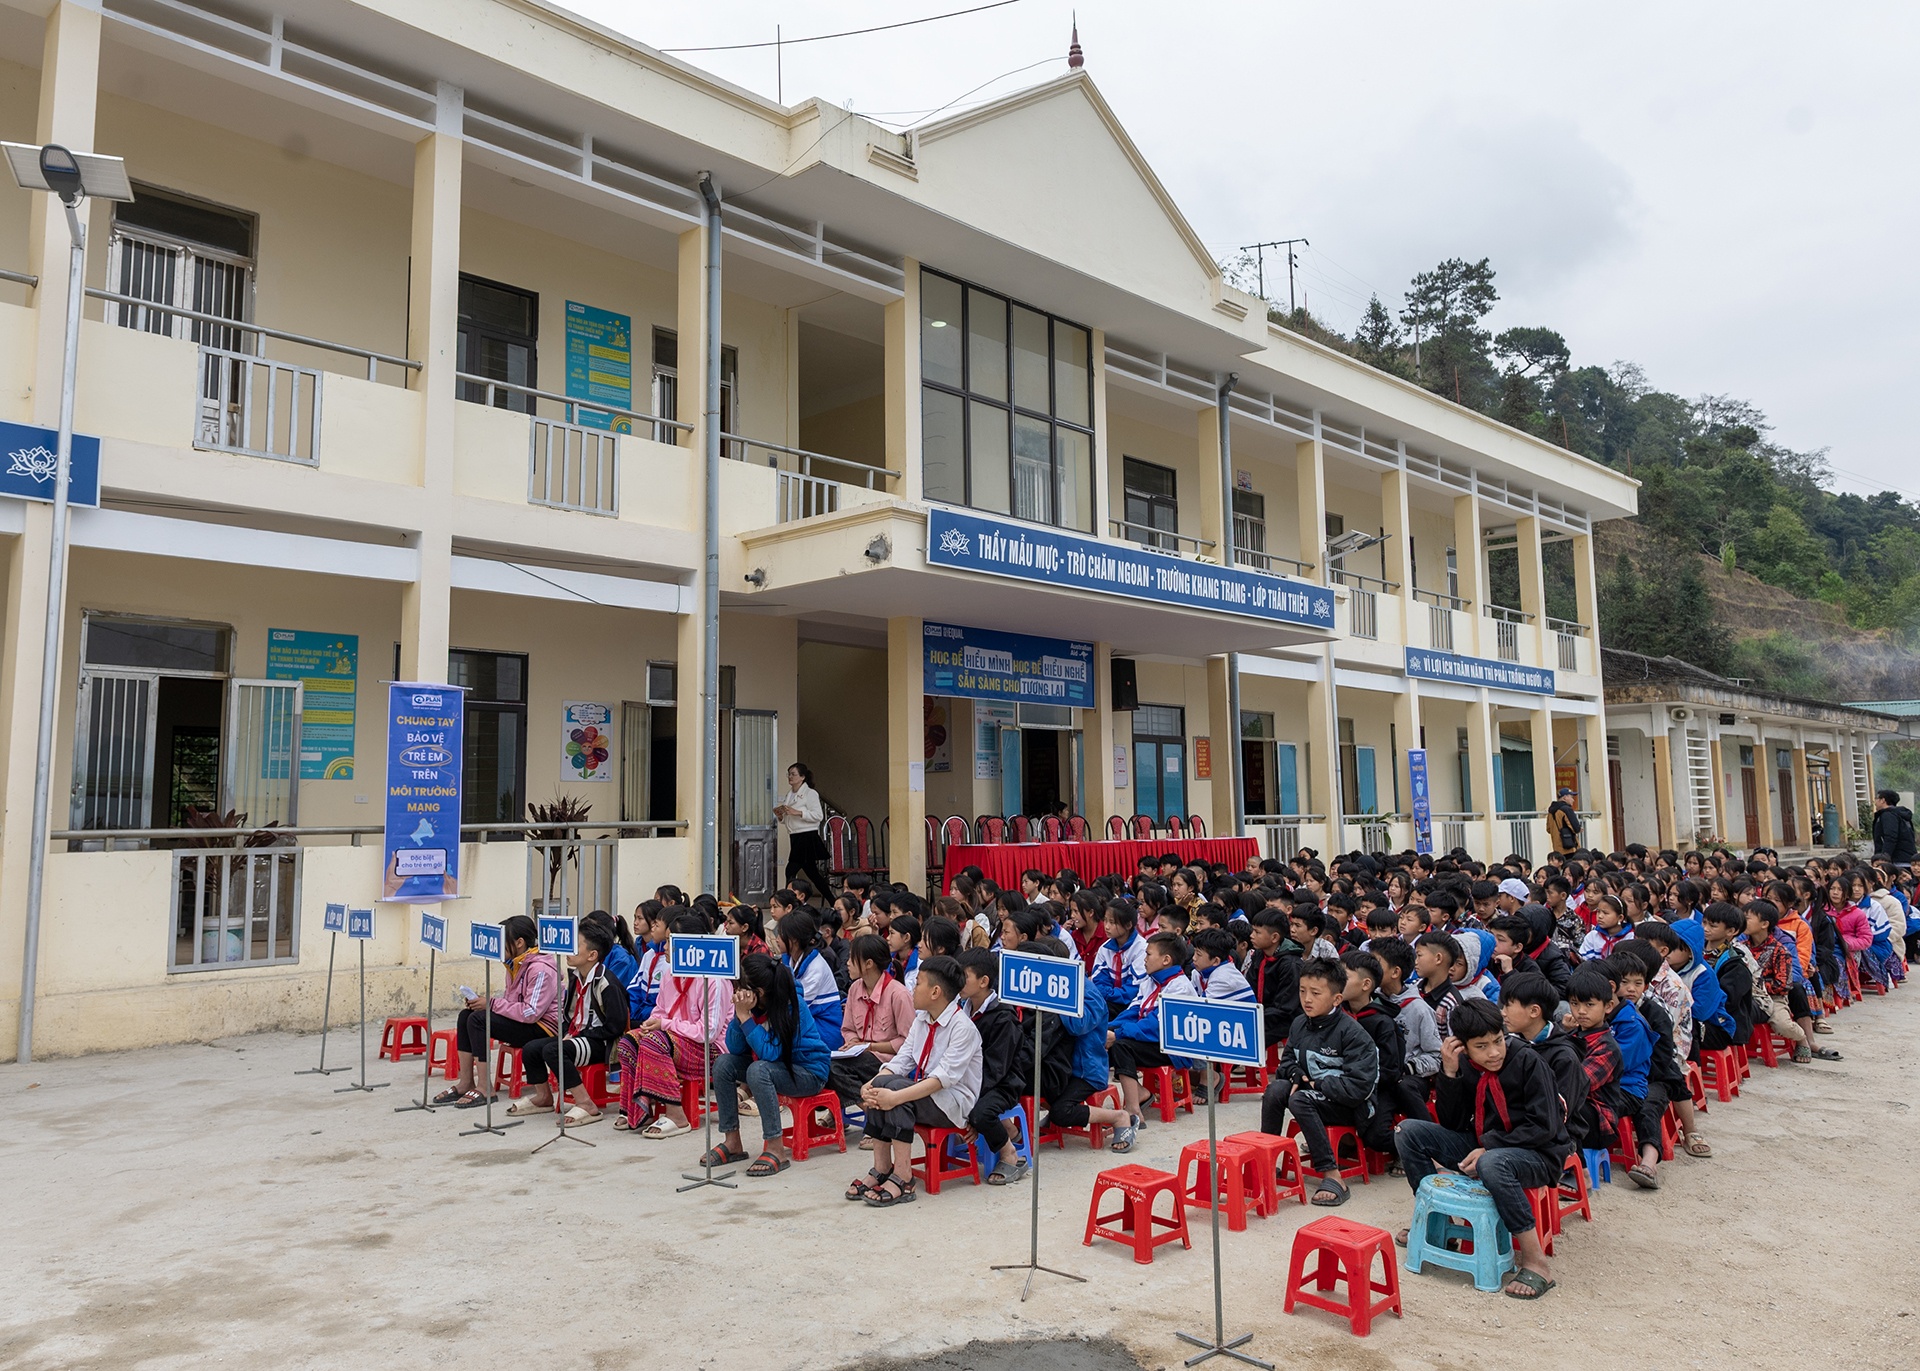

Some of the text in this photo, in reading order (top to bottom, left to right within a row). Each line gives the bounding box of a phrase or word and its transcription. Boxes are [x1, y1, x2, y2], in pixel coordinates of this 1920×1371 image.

[978, 530, 1007, 562] THẦY
[1009, 533, 1034, 567] MẪU
[1035, 545, 1059, 574] MỰC
[1067, 548, 1086, 576] TRÒ
[1088, 553, 1116, 582] CHĂM
[1118, 560, 1149, 588] NGOAN
[1156, 566, 1190, 594] TRƯỜNG
[1192, 574, 1220, 600] KHANG
[1221, 581, 1246, 604] TRANG
[1252, 583, 1266, 608] LỚP
[1268, 588, 1286, 612] THÂN
[1288, 591, 1309, 618] THIỆN
[1070, 643, 1092, 652] Australian
[930, 650, 950, 667] HỌC
[966, 650, 986, 668] HIỂU
[988, 655, 1010, 672] MÌNH
[1014, 660, 1030, 676] HỌC
[1044, 658, 1062, 677] HIỂU
[1424, 655, 1430, 672] VÌ
[1432, 658, 1441, 676] LỢI
[1442, 658, 1453, 675] ÍCH
[1454, 660, 1470, 678] TRĂM
[1470, 662, 1484, 680] NĂM
[1484, 665, 1494, 681] THÌ
[1494, 665, 1508, 682] PHẢI
[1526, 672, 1542, 688] NGƯỜI
[958, 670, 1064, 697] SẴN SÀNG CHO TƯƠNG LAI
[396, 716, 455, 727] CHUNG TAY
[407, 731, 444, 746] BẢO VỆ
[408, 750, 443, 761] TRẺ EM
[412, 770, 438, 780] TRÊN
[390, 785, 457, 797] MÔI TRƯỜNG
[407, 803, 440, 815] MẠNG
[326, 910, 342, 925] LỚP 9B
[351, 916, 370, 933] LỚP 9A
[424, 921, 442, 943] LỚP 8B
[474, 931, 498, 953] LỚP 8A
[542, 924, 570, 945] LỚP 7B
[679, 945, 728, 968] LỚP 7A
[1010, 966, 1070, 998] LỚP 6B
[1172, 1010, 1247, 1049] LỚP 6A
